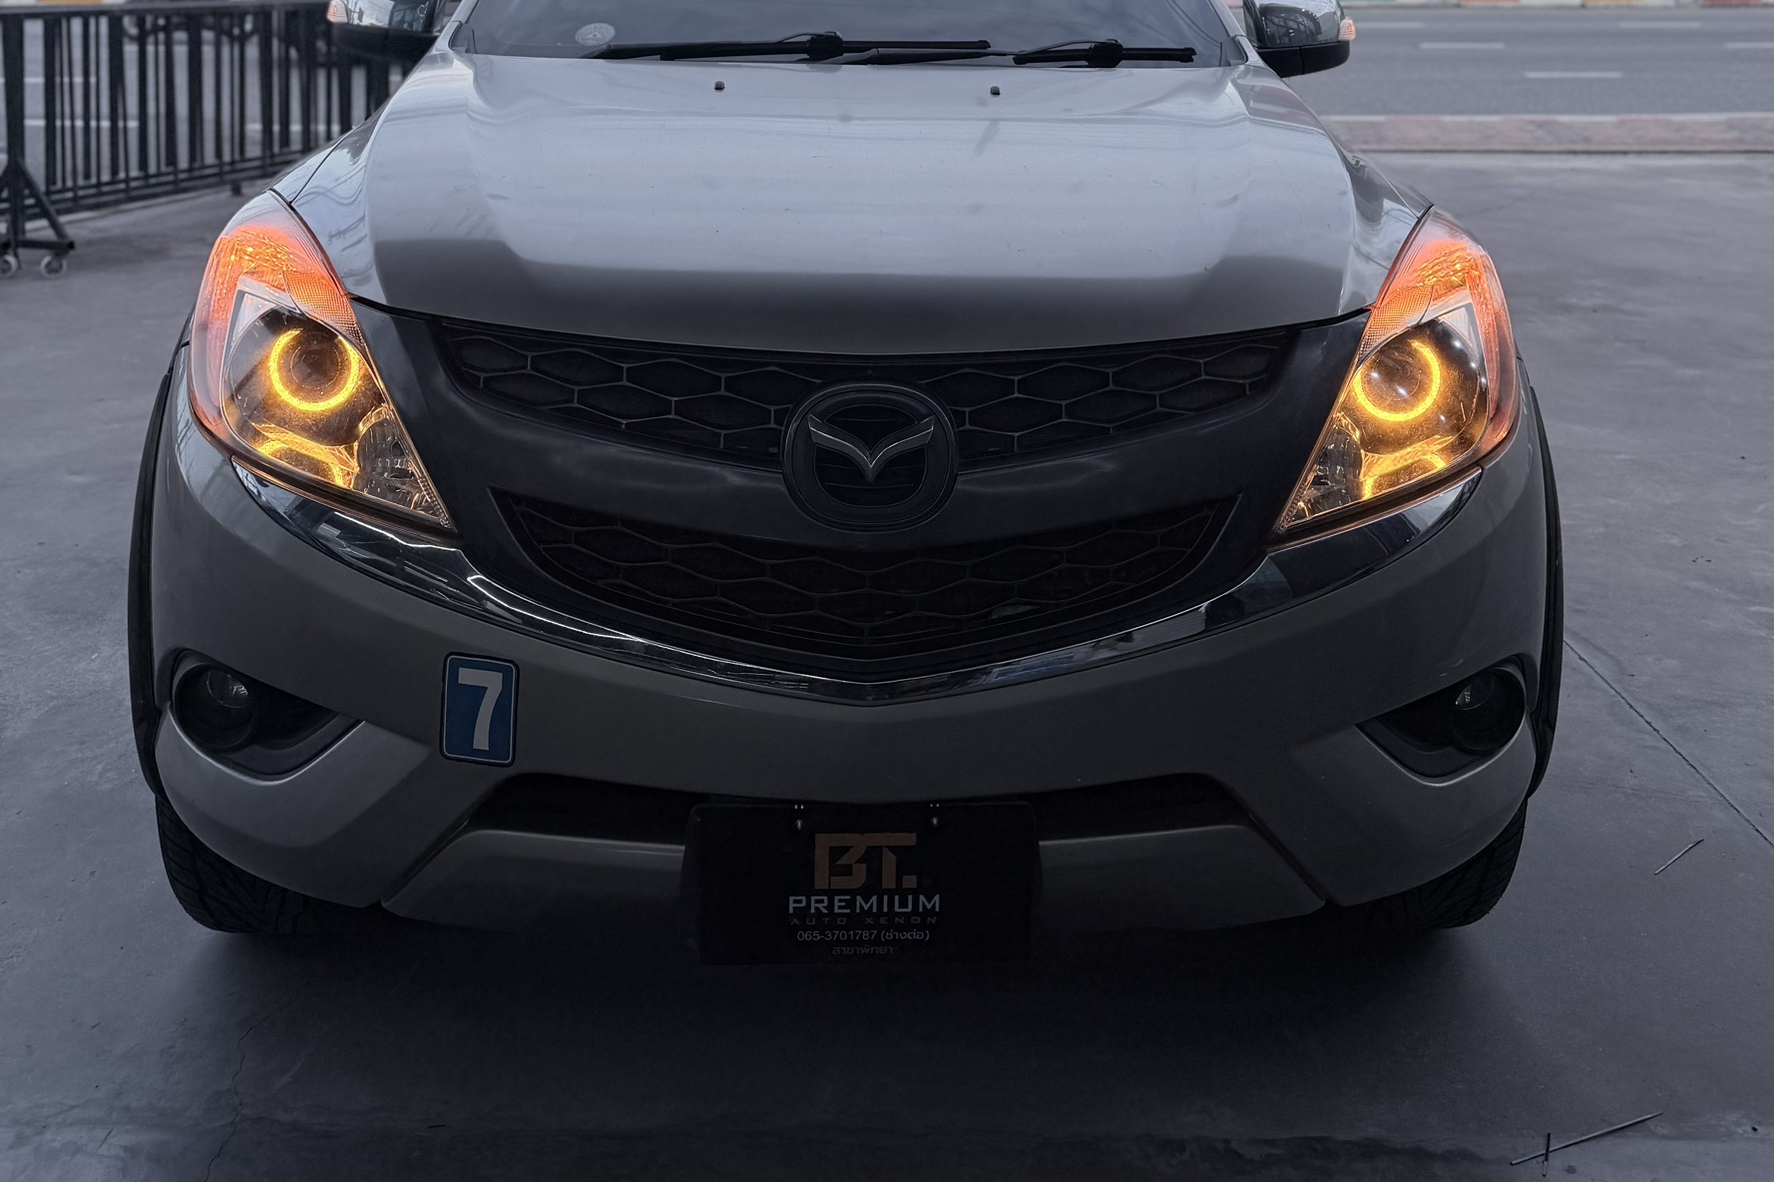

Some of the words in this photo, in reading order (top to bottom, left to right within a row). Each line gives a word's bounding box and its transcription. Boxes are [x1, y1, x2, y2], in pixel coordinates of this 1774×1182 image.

[458, 667, 503, 751] 7
[788, 893, 940, 914] PREMIUM
[790, 917, 848, 926] AUTO
[865, 916, 937, 925] XENON
[797, 930, 877, 941] 065-3701787
[880, 929, 930, 942] (ช่างต่อ)
